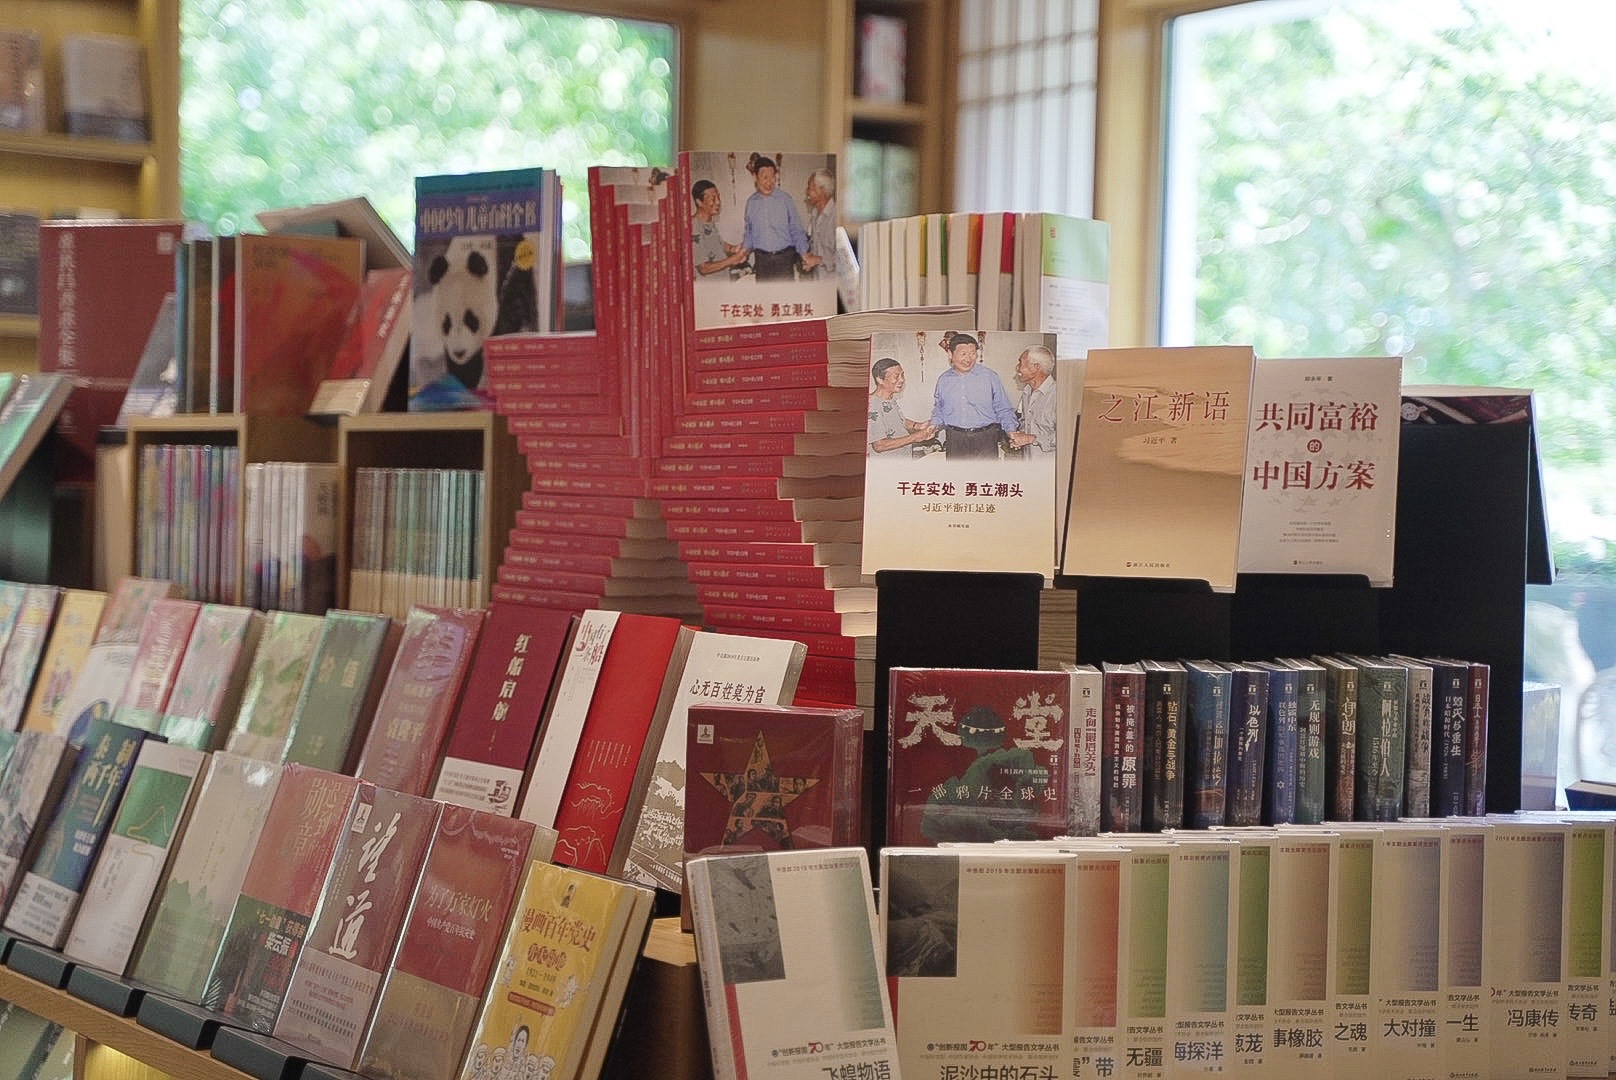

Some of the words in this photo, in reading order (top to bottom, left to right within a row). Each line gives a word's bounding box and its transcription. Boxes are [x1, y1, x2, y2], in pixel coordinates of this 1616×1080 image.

[720, 304, 764, 317] 干在实处
[771, 304, 814, 316] 勇立潮头
[1098, 391, 1230, 422] 之江新语
[1256, 402, 1378, 432] 共同富裕
[1308, 439, 1322, 453] 的
[1253, 460, 1376, 490] 中国方案
[897, 481, 955, 497] 干在实处
[965, 482, 1023, 497] 勇立潮头
[921, 502, 996, 513] 习近平浙江足迹
[491, 634, 532, 721] 红船启航
[690, 680, 766, 703] 心无百姓莫为官
[1309, 699, 1321, 759] 无规则游戏
[1450, 695, 1466, 757] 毁灭与重生
[908, 785, 1058, 802] 一部鸦片全球史
[1236, 1013, 1265, 1021] 文学丛书
[1506, 1008, 1560, 1027] 冯康传
[1567, 1003, 1598, 1021] 传奇
[1334, 1022, 1368, 1041] 之魂
[1383, 1018, 1437, 1037] 大对撞
[1446, 1013, 1480, 1032] 一生
[1273, 1028, 1323, 1048] 事橡胶
[1126, 1047, 1163, 1067] 无疆
[822, 1060, 890, 1080] 飞蝗物语
[940, 1064, 1059, 1080] 泥沙中的石头
